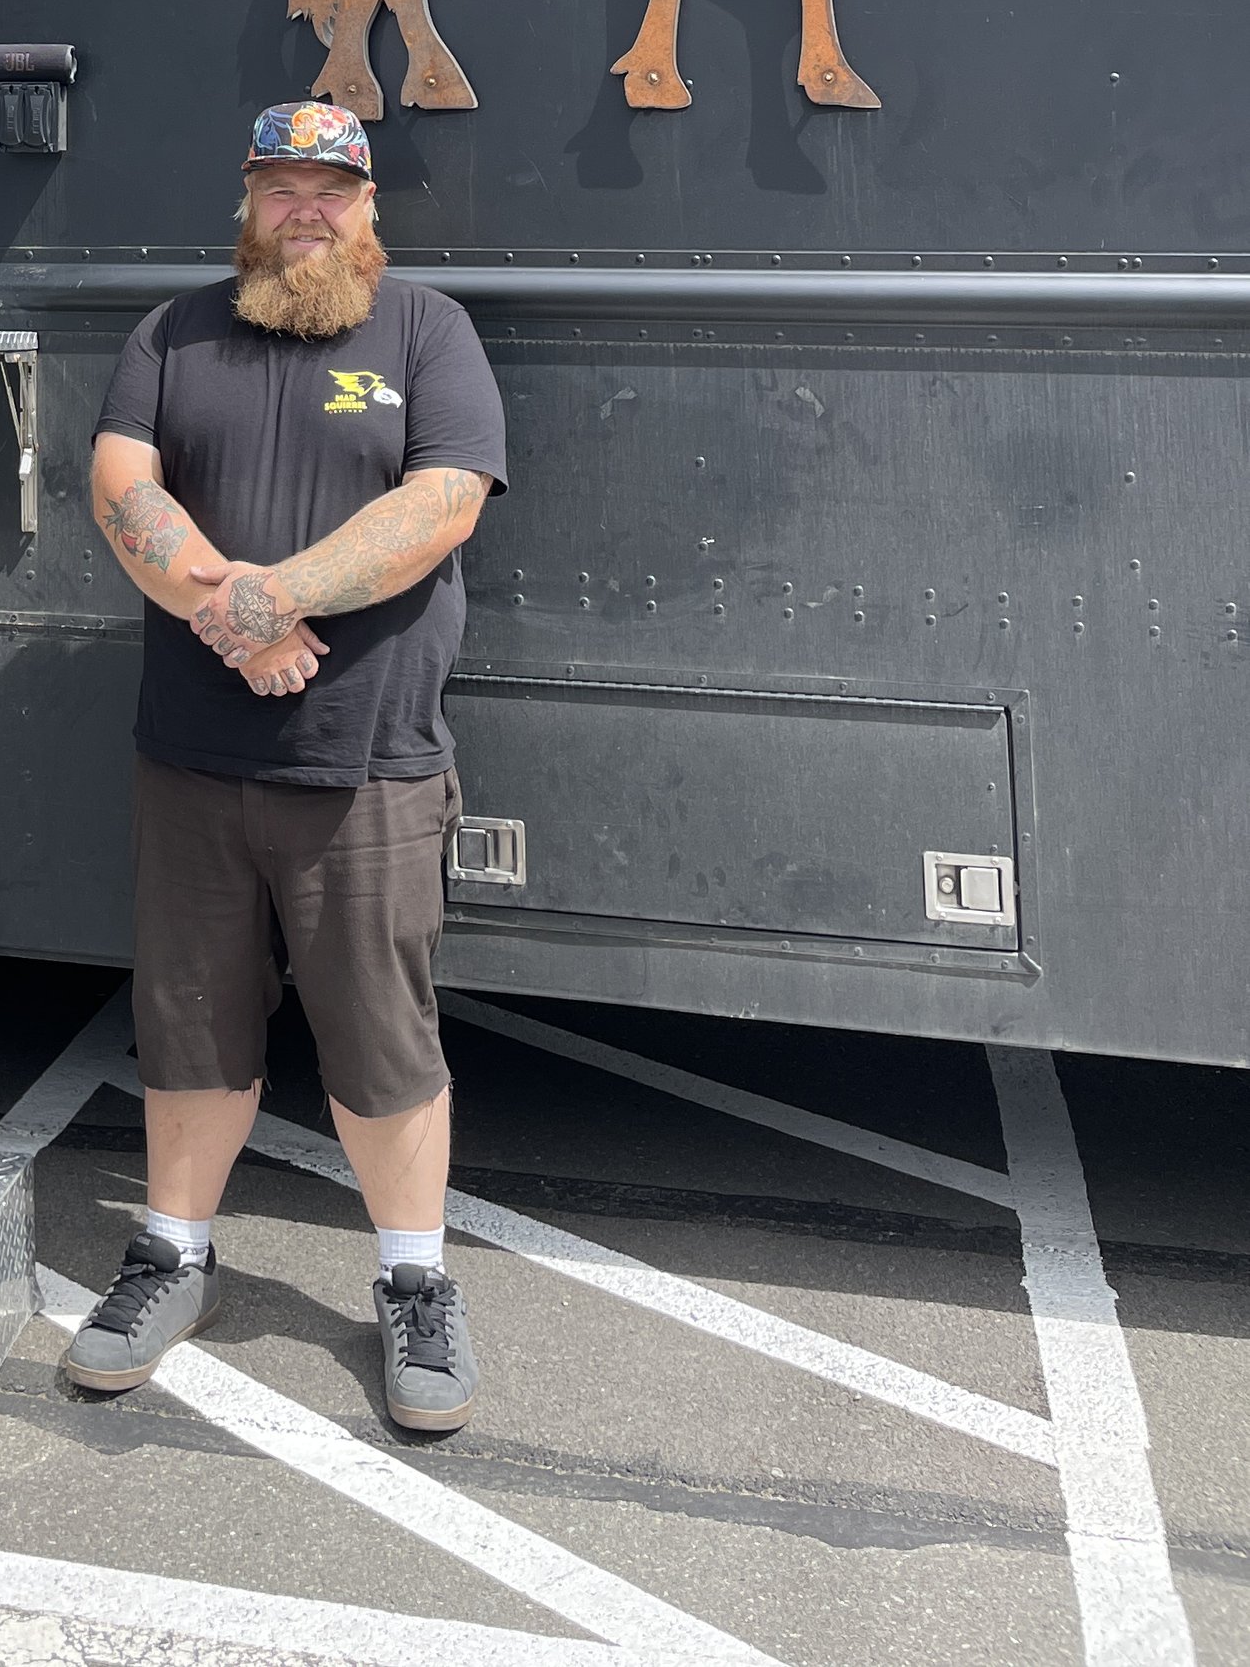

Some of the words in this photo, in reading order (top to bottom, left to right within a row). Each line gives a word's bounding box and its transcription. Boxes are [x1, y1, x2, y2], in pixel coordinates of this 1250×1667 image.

[5, 53, 35, 72] JBL
[335, 394, 357, 402] MAD
[324, 401, 368, 411] SQUIRREL
